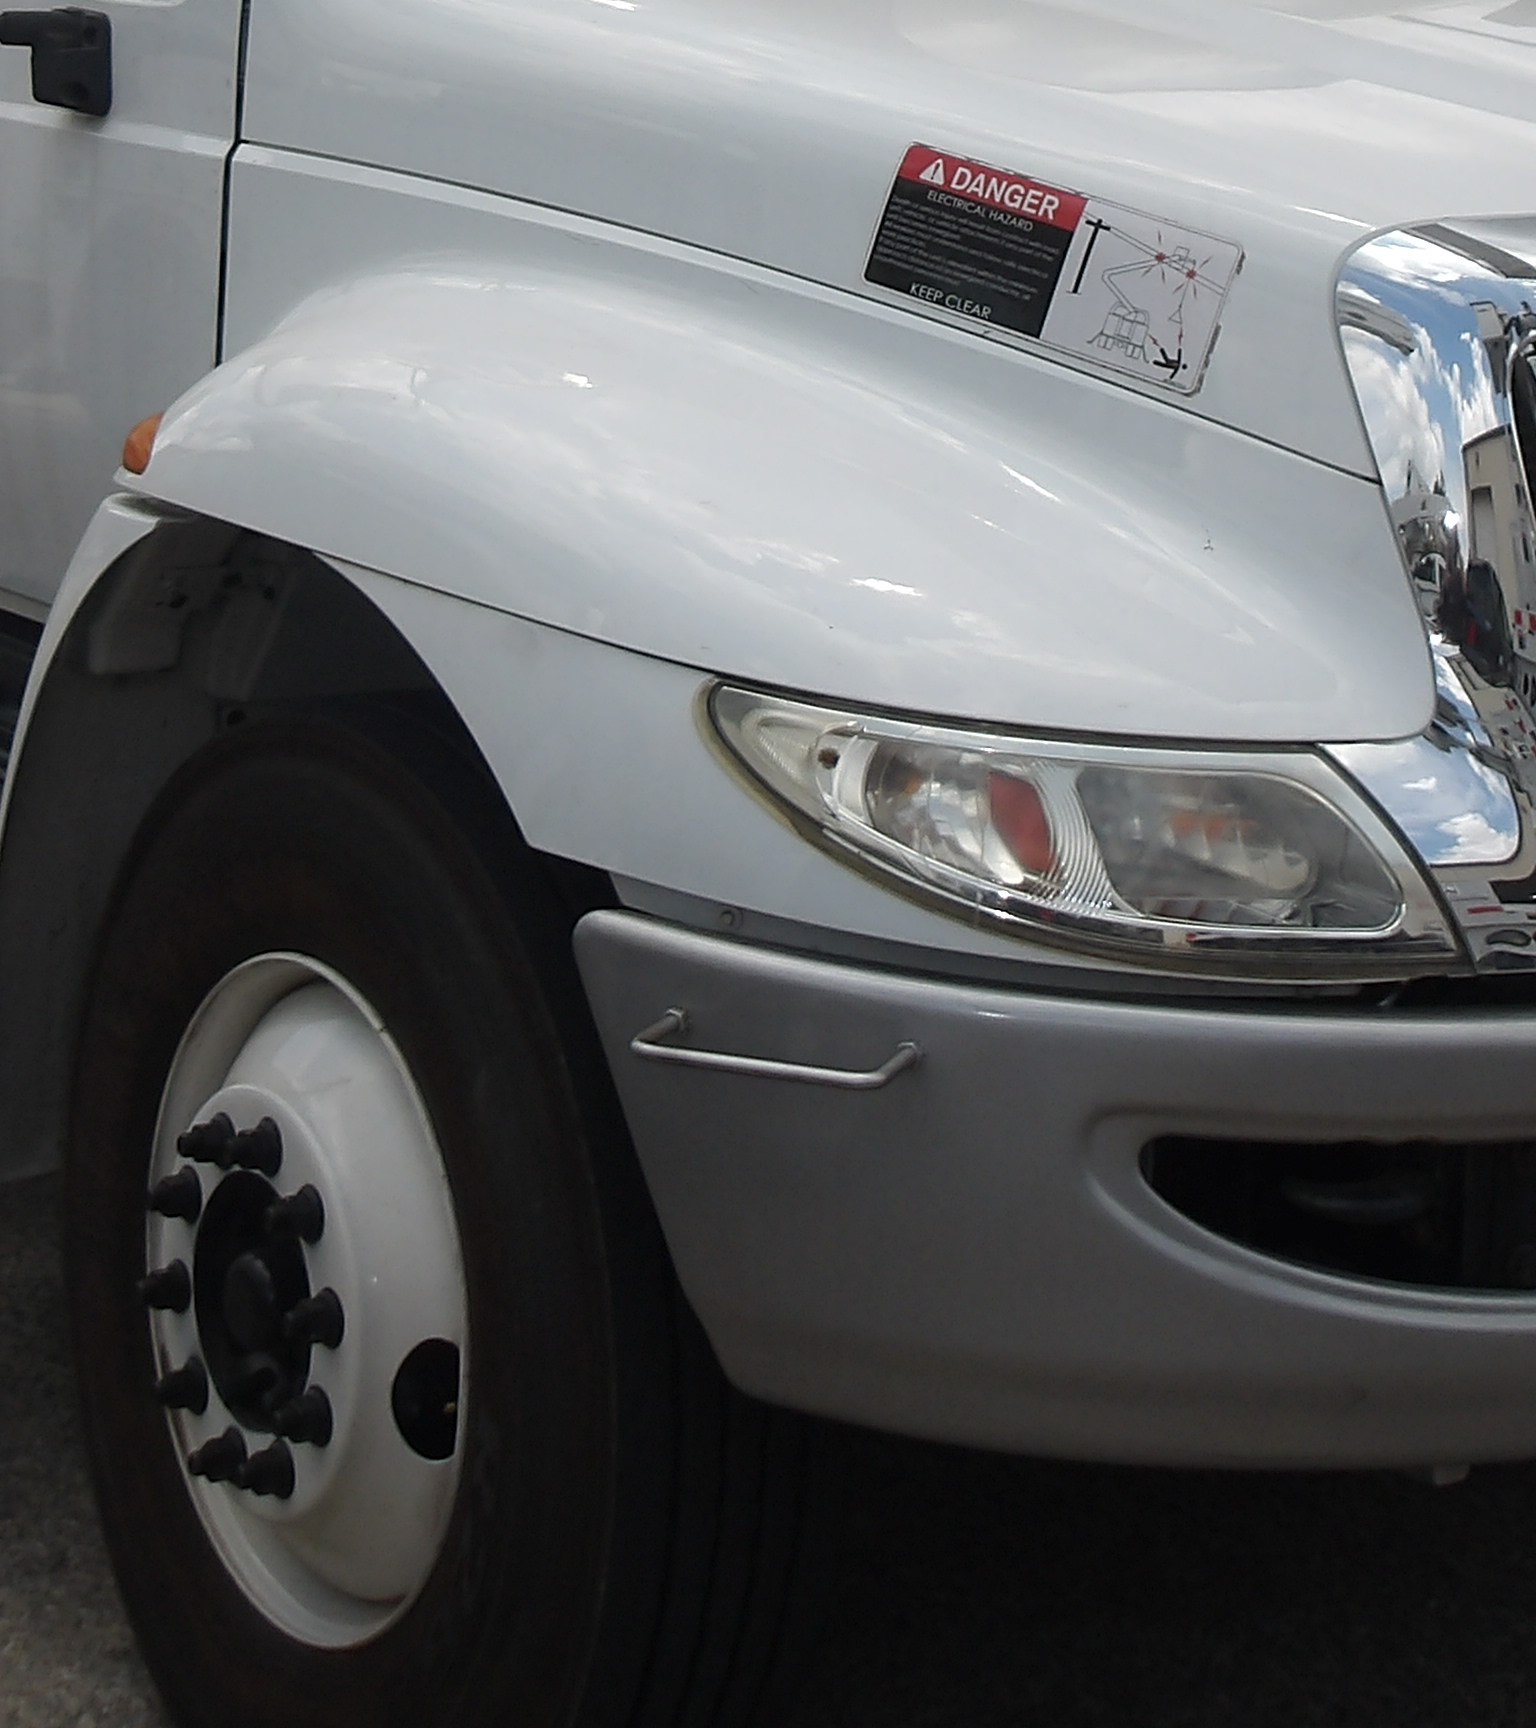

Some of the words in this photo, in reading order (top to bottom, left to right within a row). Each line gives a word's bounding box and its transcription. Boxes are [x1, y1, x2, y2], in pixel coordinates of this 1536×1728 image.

[927, 190, 986, 218] ELECTRICAL
[989, 210, 1034, 233] HAZARD
[951, 165, 1061, 221] DANGER
[909, 282, 944, 303] KEEP
[945, 293, 993, 321] CLEAR
